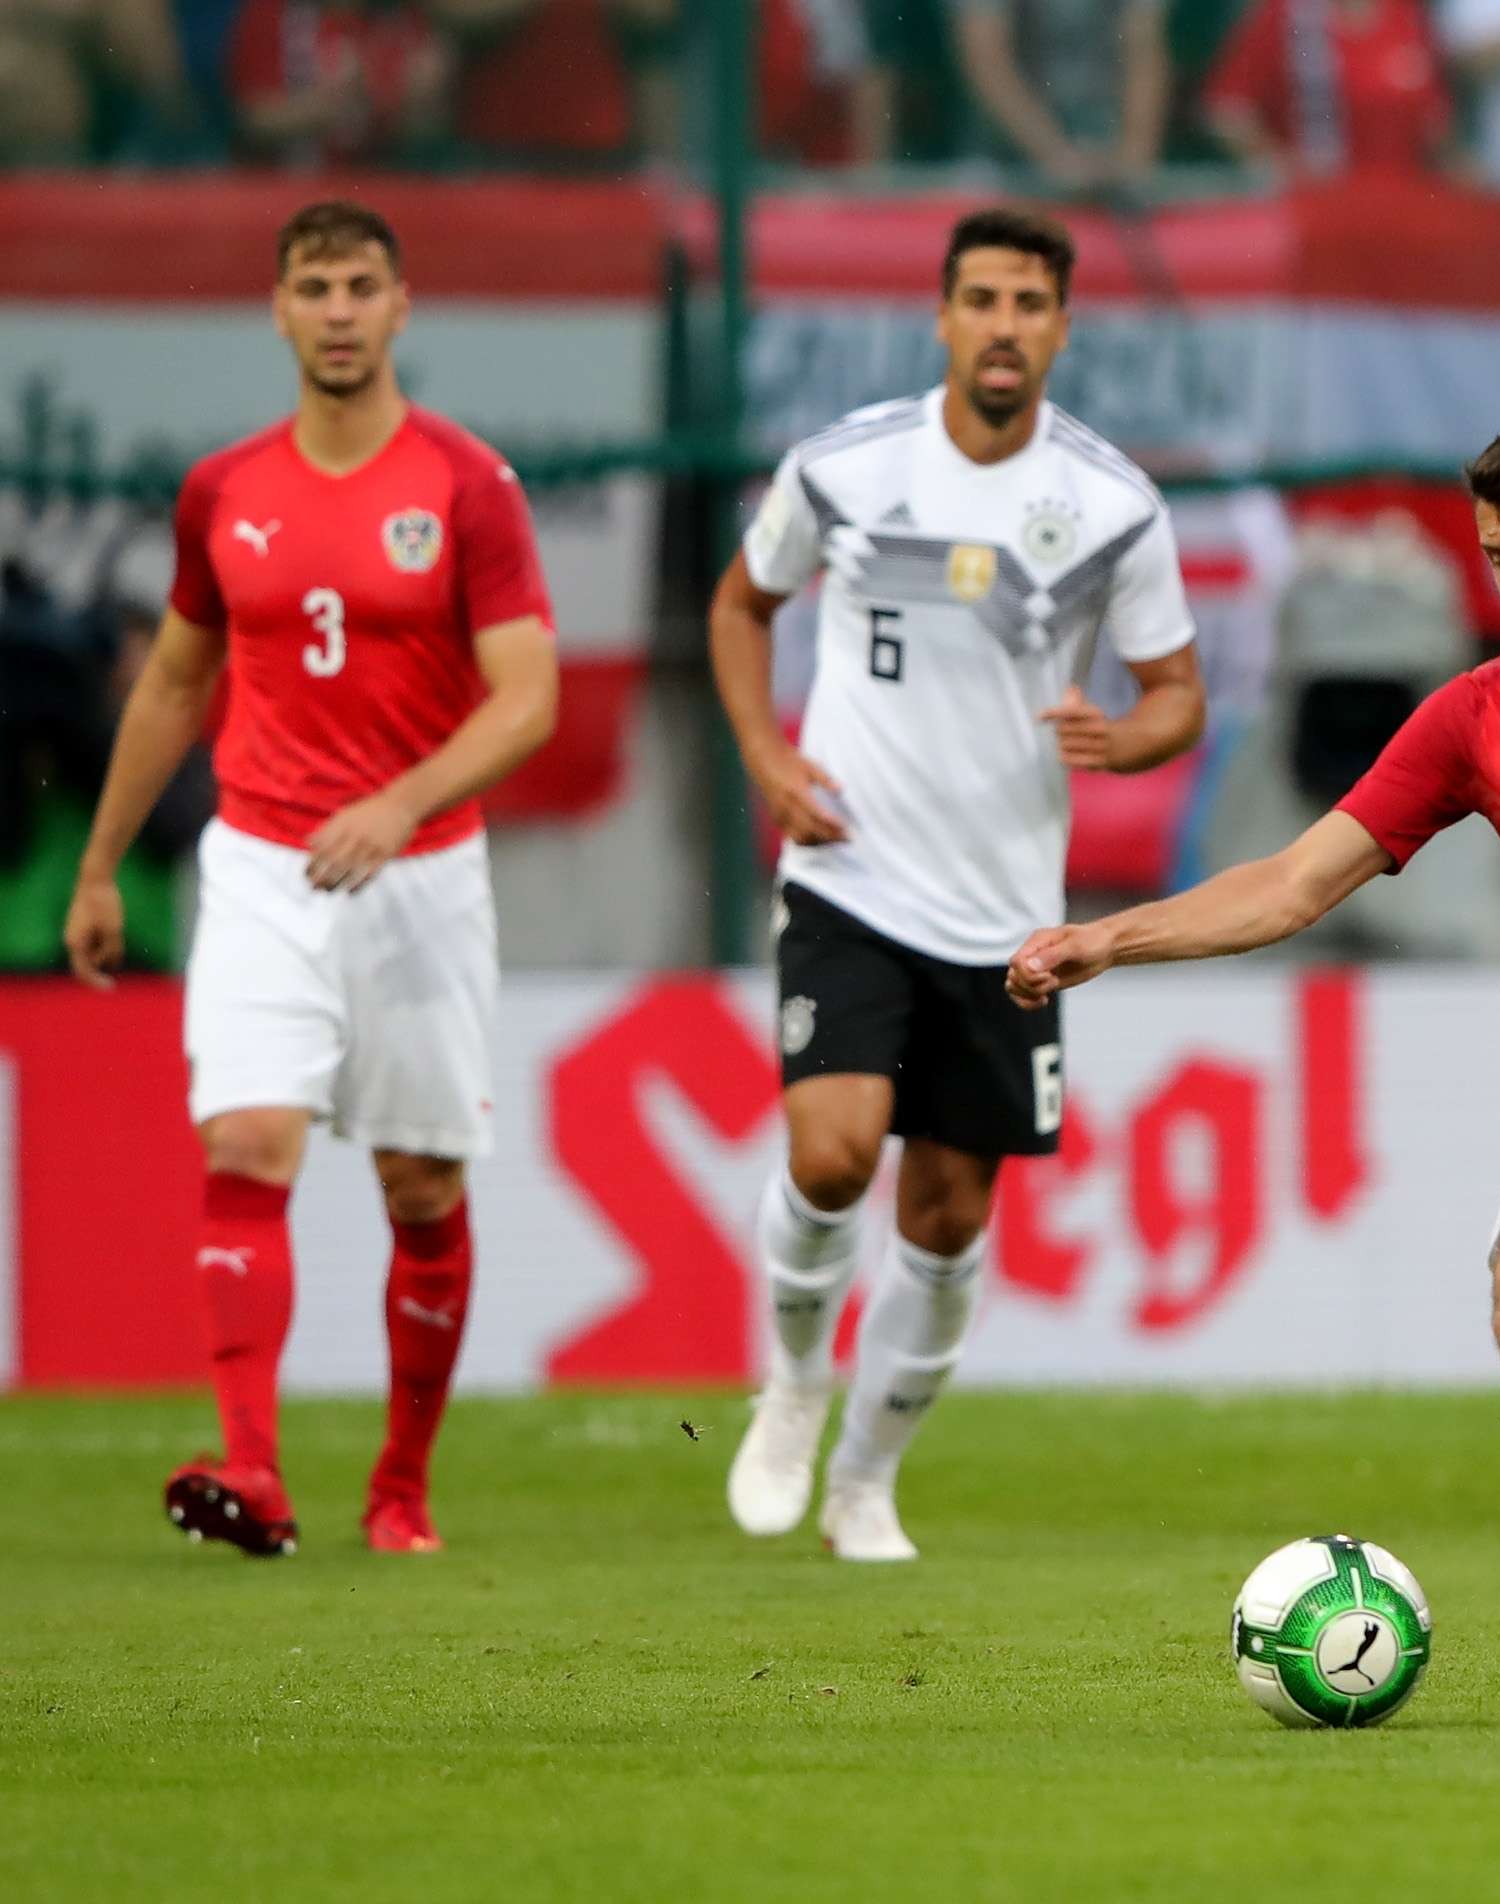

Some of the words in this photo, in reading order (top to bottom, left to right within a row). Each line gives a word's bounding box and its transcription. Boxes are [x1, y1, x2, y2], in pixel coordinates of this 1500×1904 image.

[301, 586, 347, 678] 3
[870, 608, 903, 682] 6
[1031, 1042, 1062, 1135] 6
